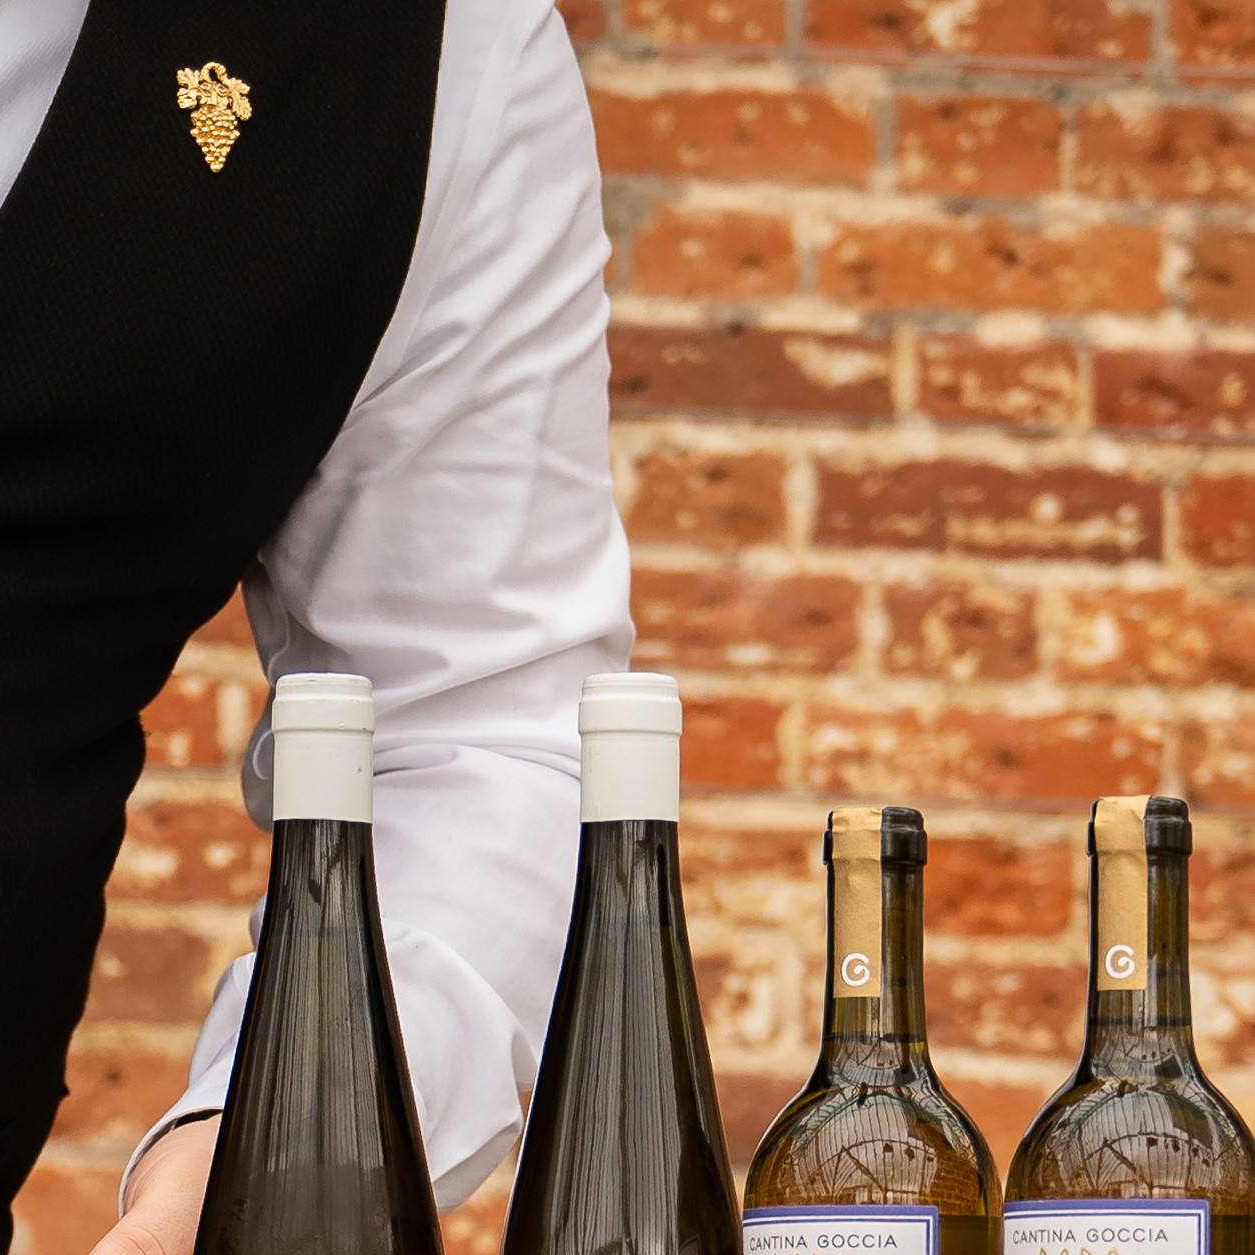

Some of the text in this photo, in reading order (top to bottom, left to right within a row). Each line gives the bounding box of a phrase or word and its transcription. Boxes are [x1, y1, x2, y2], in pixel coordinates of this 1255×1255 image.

[749, 1233, 898, 1252] CANTINA GOCCIA
[1012, 1227, 1169, 1245] CANTINA GOCCIA
